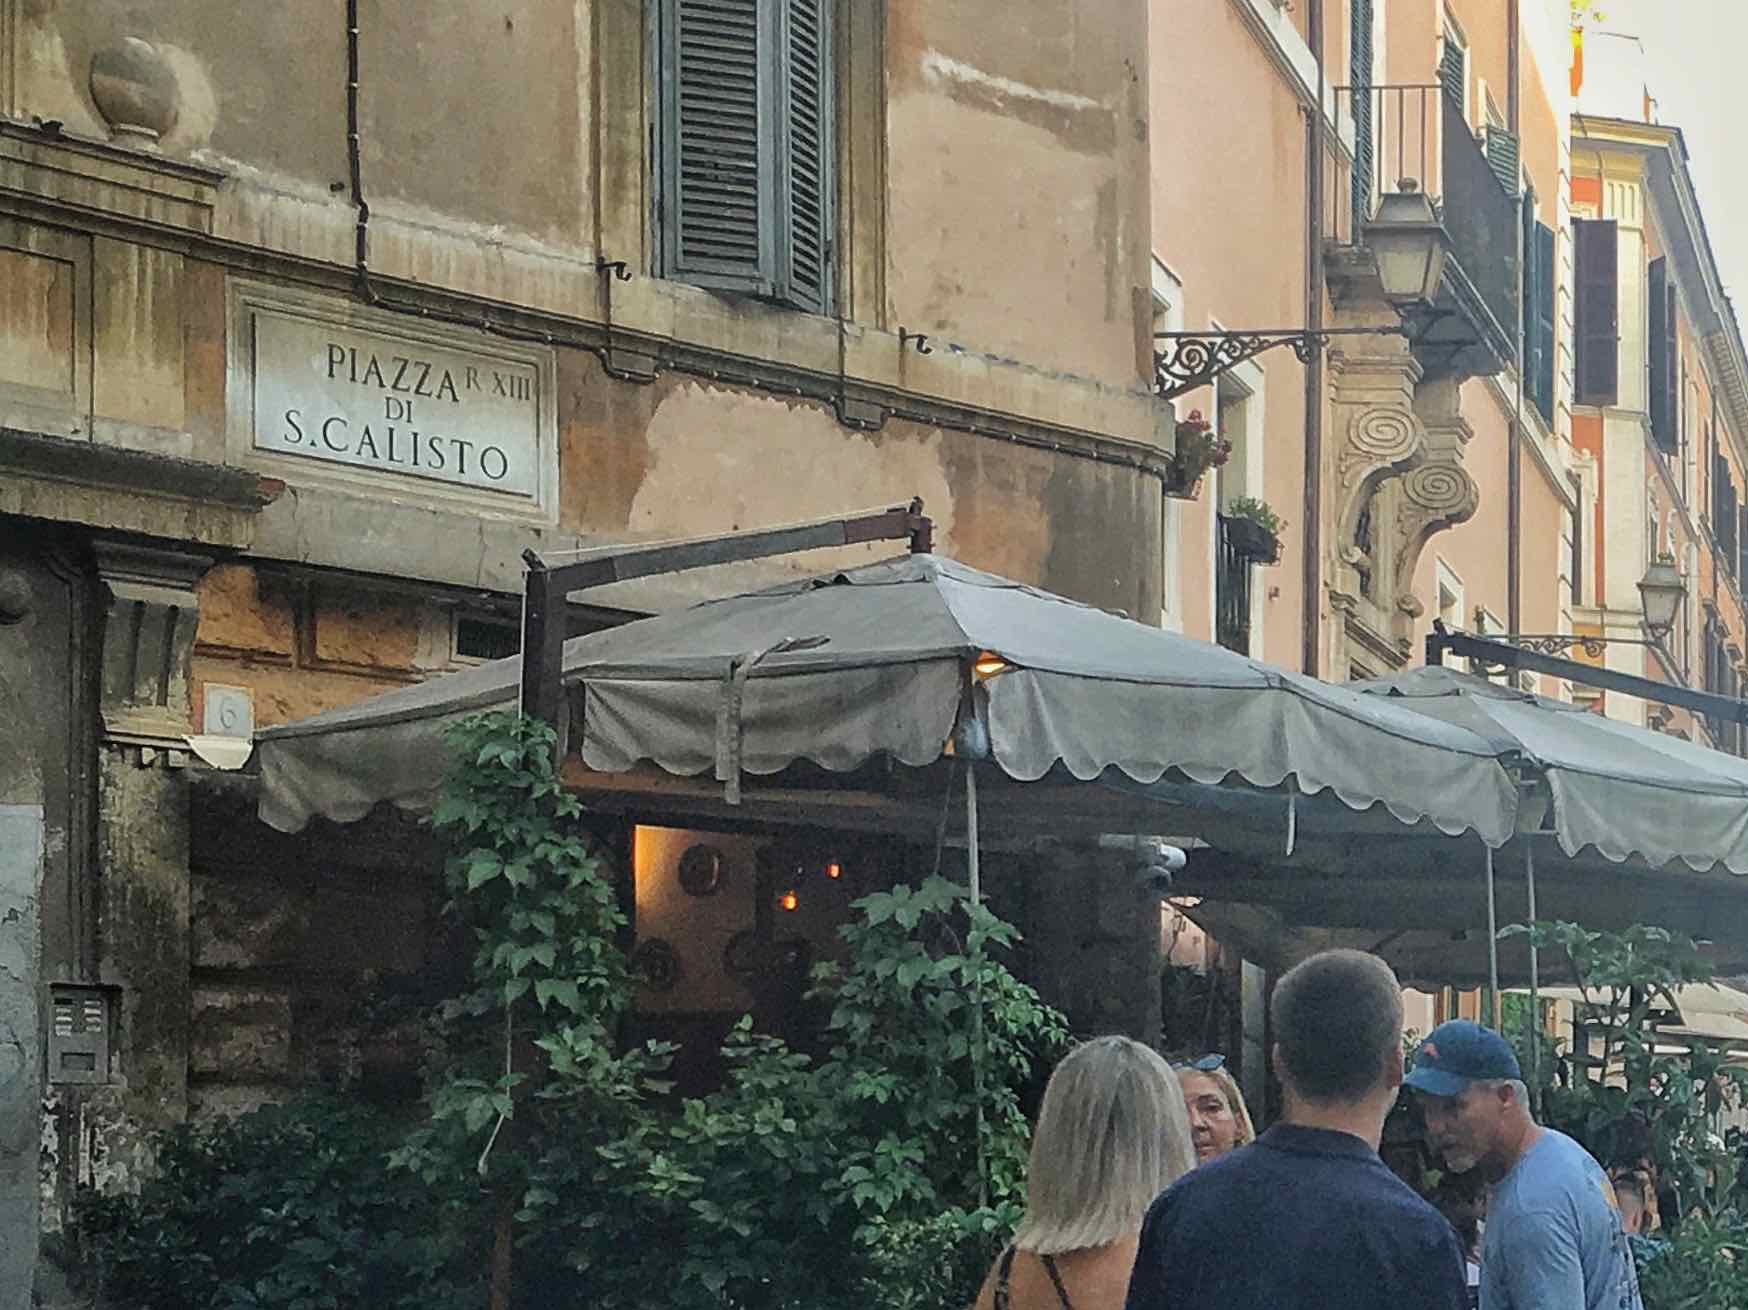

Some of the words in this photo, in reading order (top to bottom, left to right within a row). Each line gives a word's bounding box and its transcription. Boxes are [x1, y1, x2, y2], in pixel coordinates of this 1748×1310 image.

[327, 343, 460, 403] PIAZZA
[465, 365, 481, 390] R
[492, 371, 531, 401] XIII
[385, 396, 413, 424] DI
